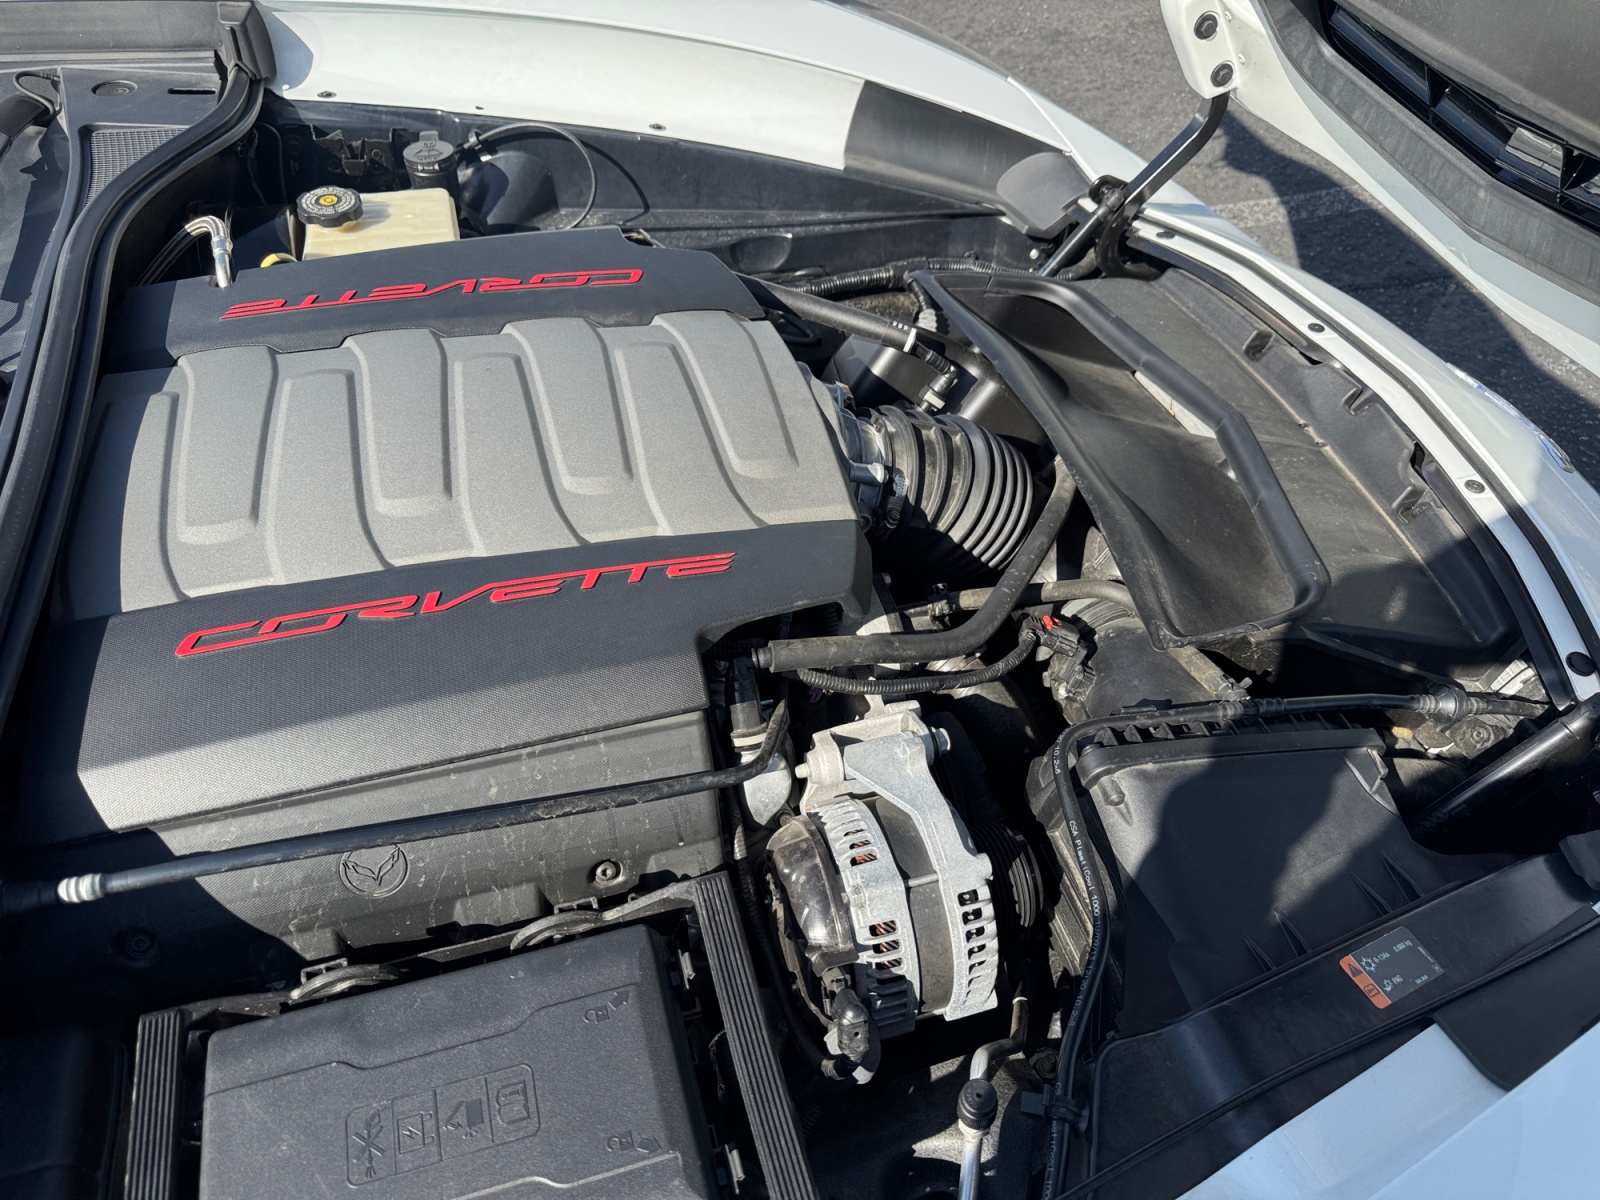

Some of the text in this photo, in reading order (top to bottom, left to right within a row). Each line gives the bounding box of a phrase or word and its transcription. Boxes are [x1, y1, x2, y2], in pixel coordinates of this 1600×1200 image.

[219, 269, 644, 321] CORVETTE
[174, 551, 737, 657] CORVETTE
[1069, 820, 1079, 837] CSA
[1091, 894, 1101, 917] 1000
